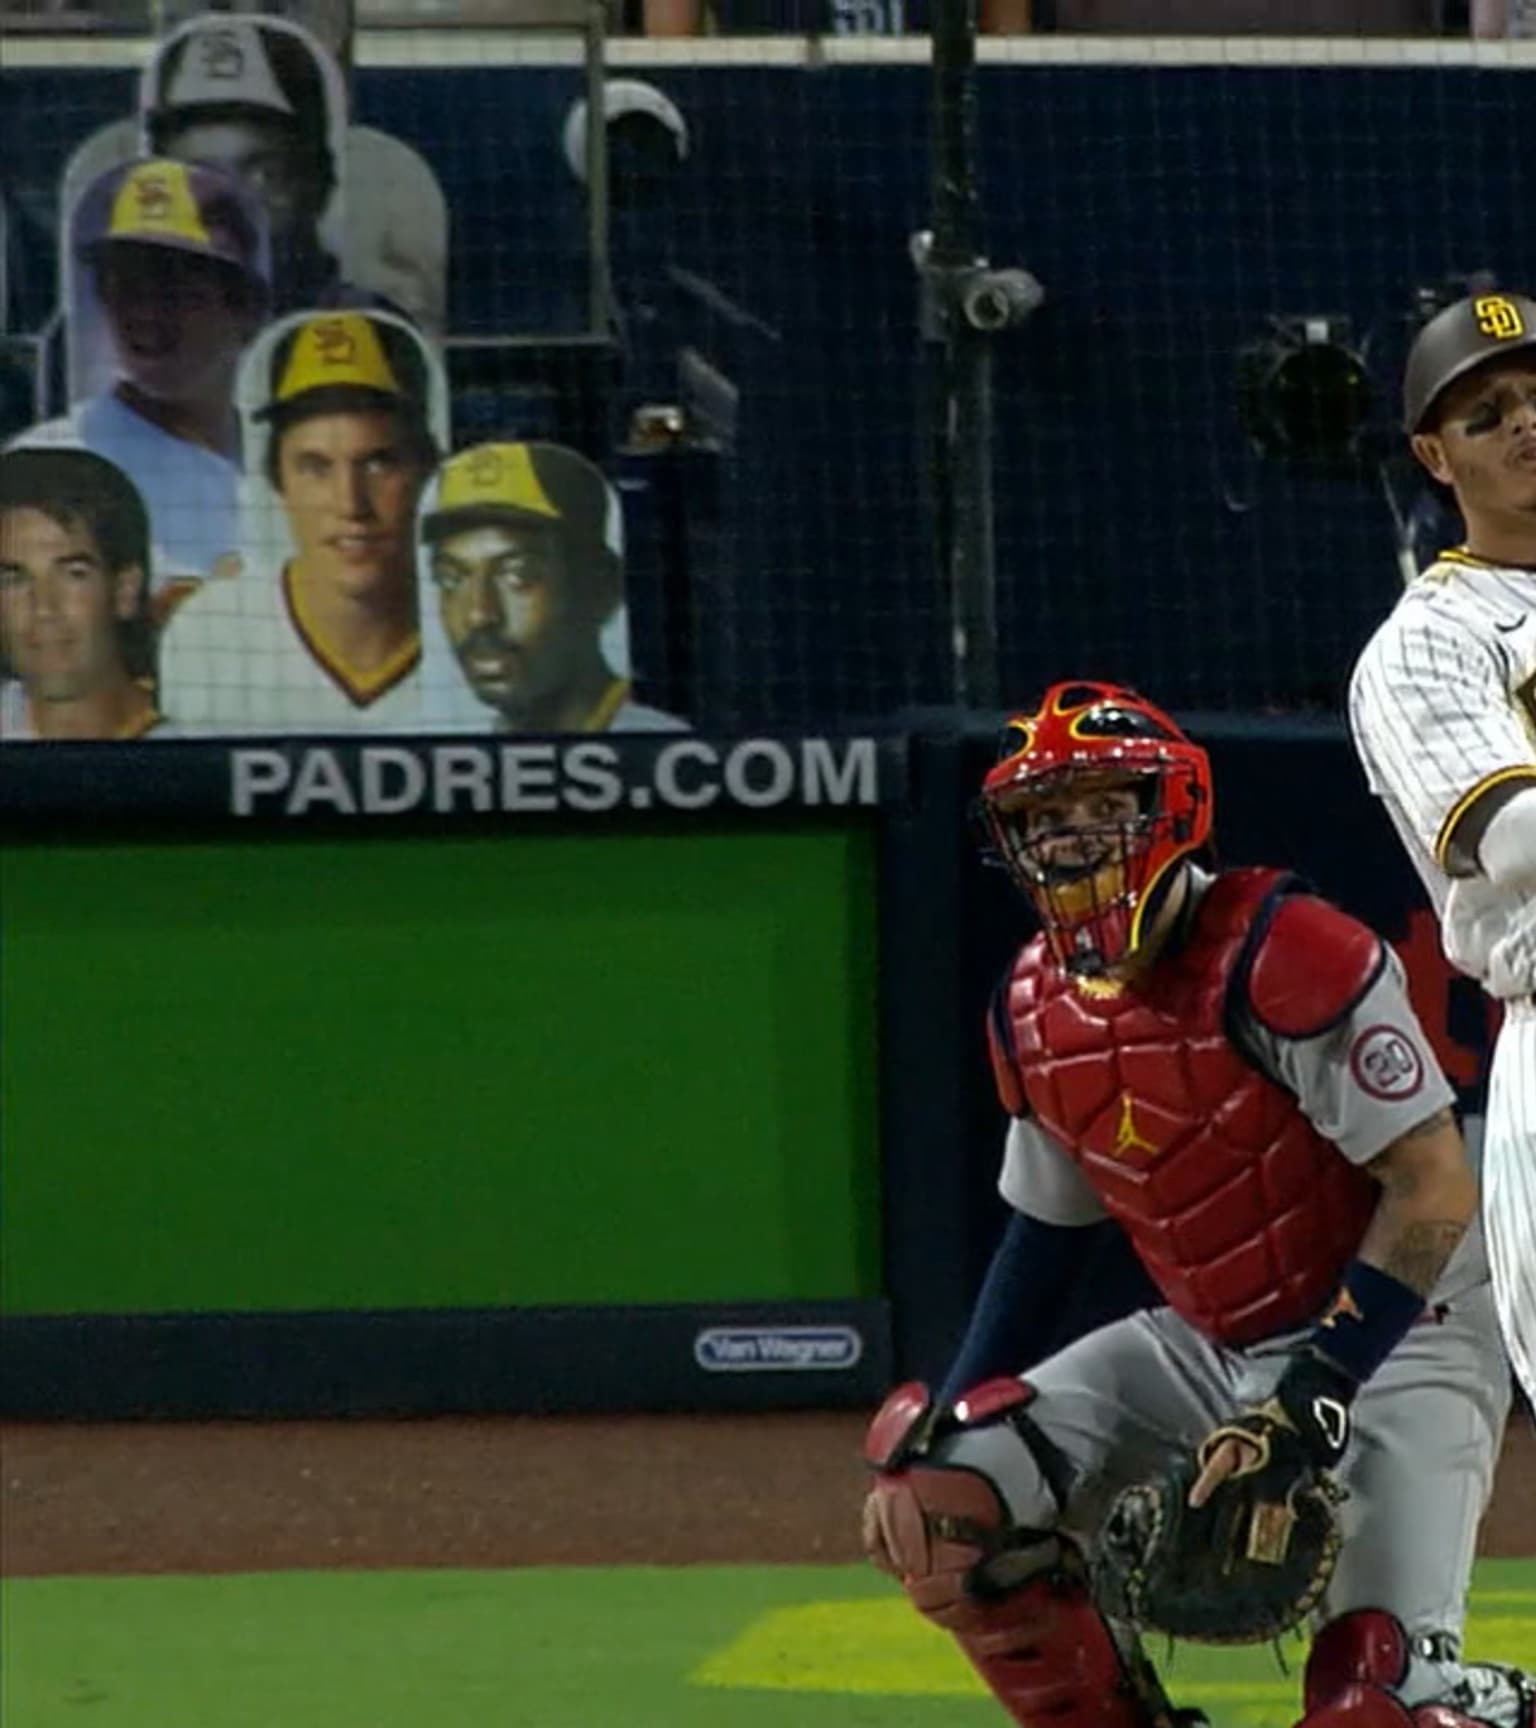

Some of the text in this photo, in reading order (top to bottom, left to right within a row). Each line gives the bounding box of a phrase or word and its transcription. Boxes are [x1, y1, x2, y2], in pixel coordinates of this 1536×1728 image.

[1475, 296, 1523, 338] SD
[229, 738, 879, 816] PADRES.COM
[1364, 1038, 1415, 1089] 20
